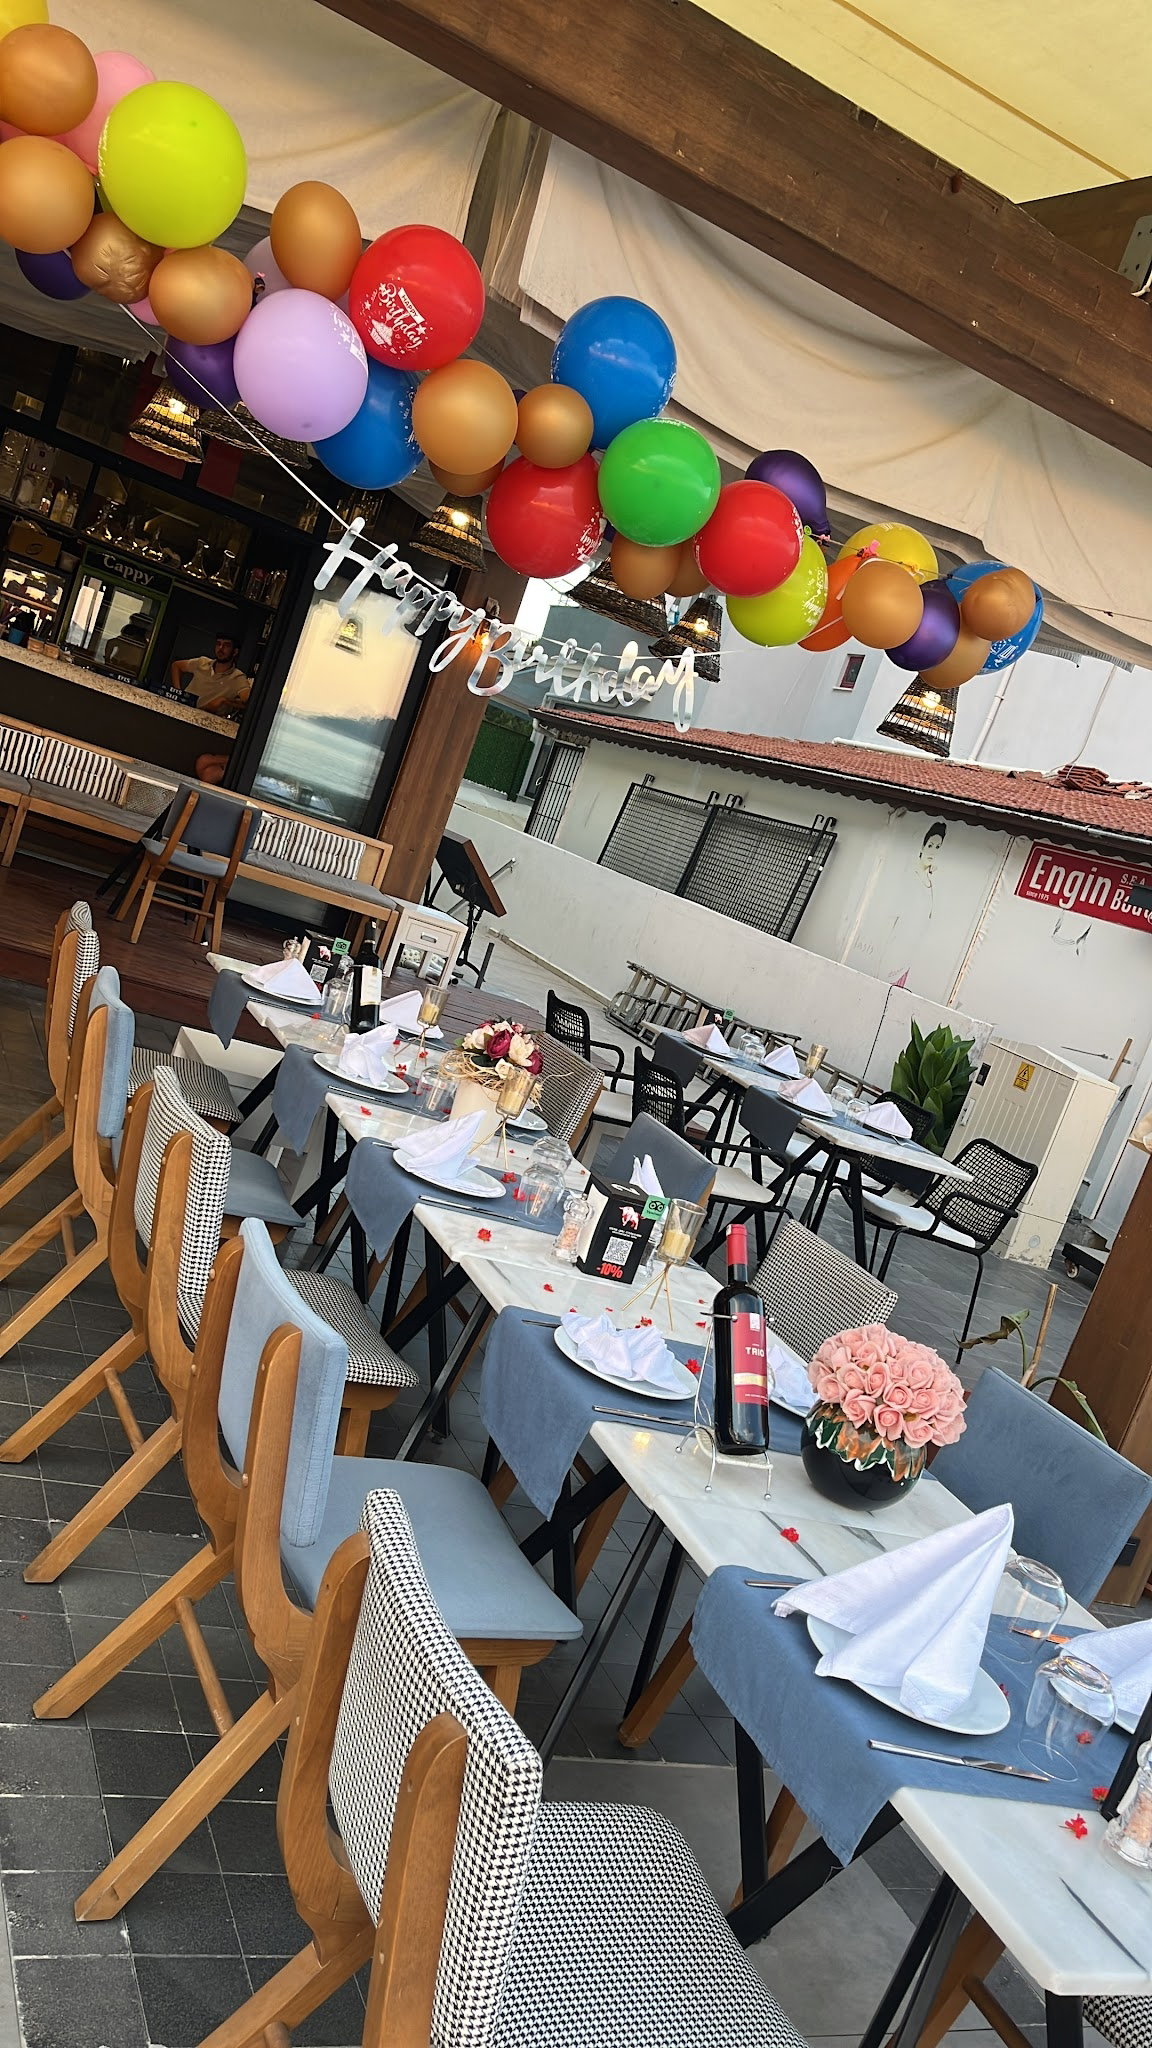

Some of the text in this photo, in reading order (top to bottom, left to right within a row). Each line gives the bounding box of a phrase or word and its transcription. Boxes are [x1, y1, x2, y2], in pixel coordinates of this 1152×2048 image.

[101, 553, 155, 586] Cappy
[314, 517, 699, 733] Happy Birthday
[1029, 854, 1112, 909] Engin
[596, 1262, 624, 1280] -10%
[745, 1346, 765, 1358] TRIO
